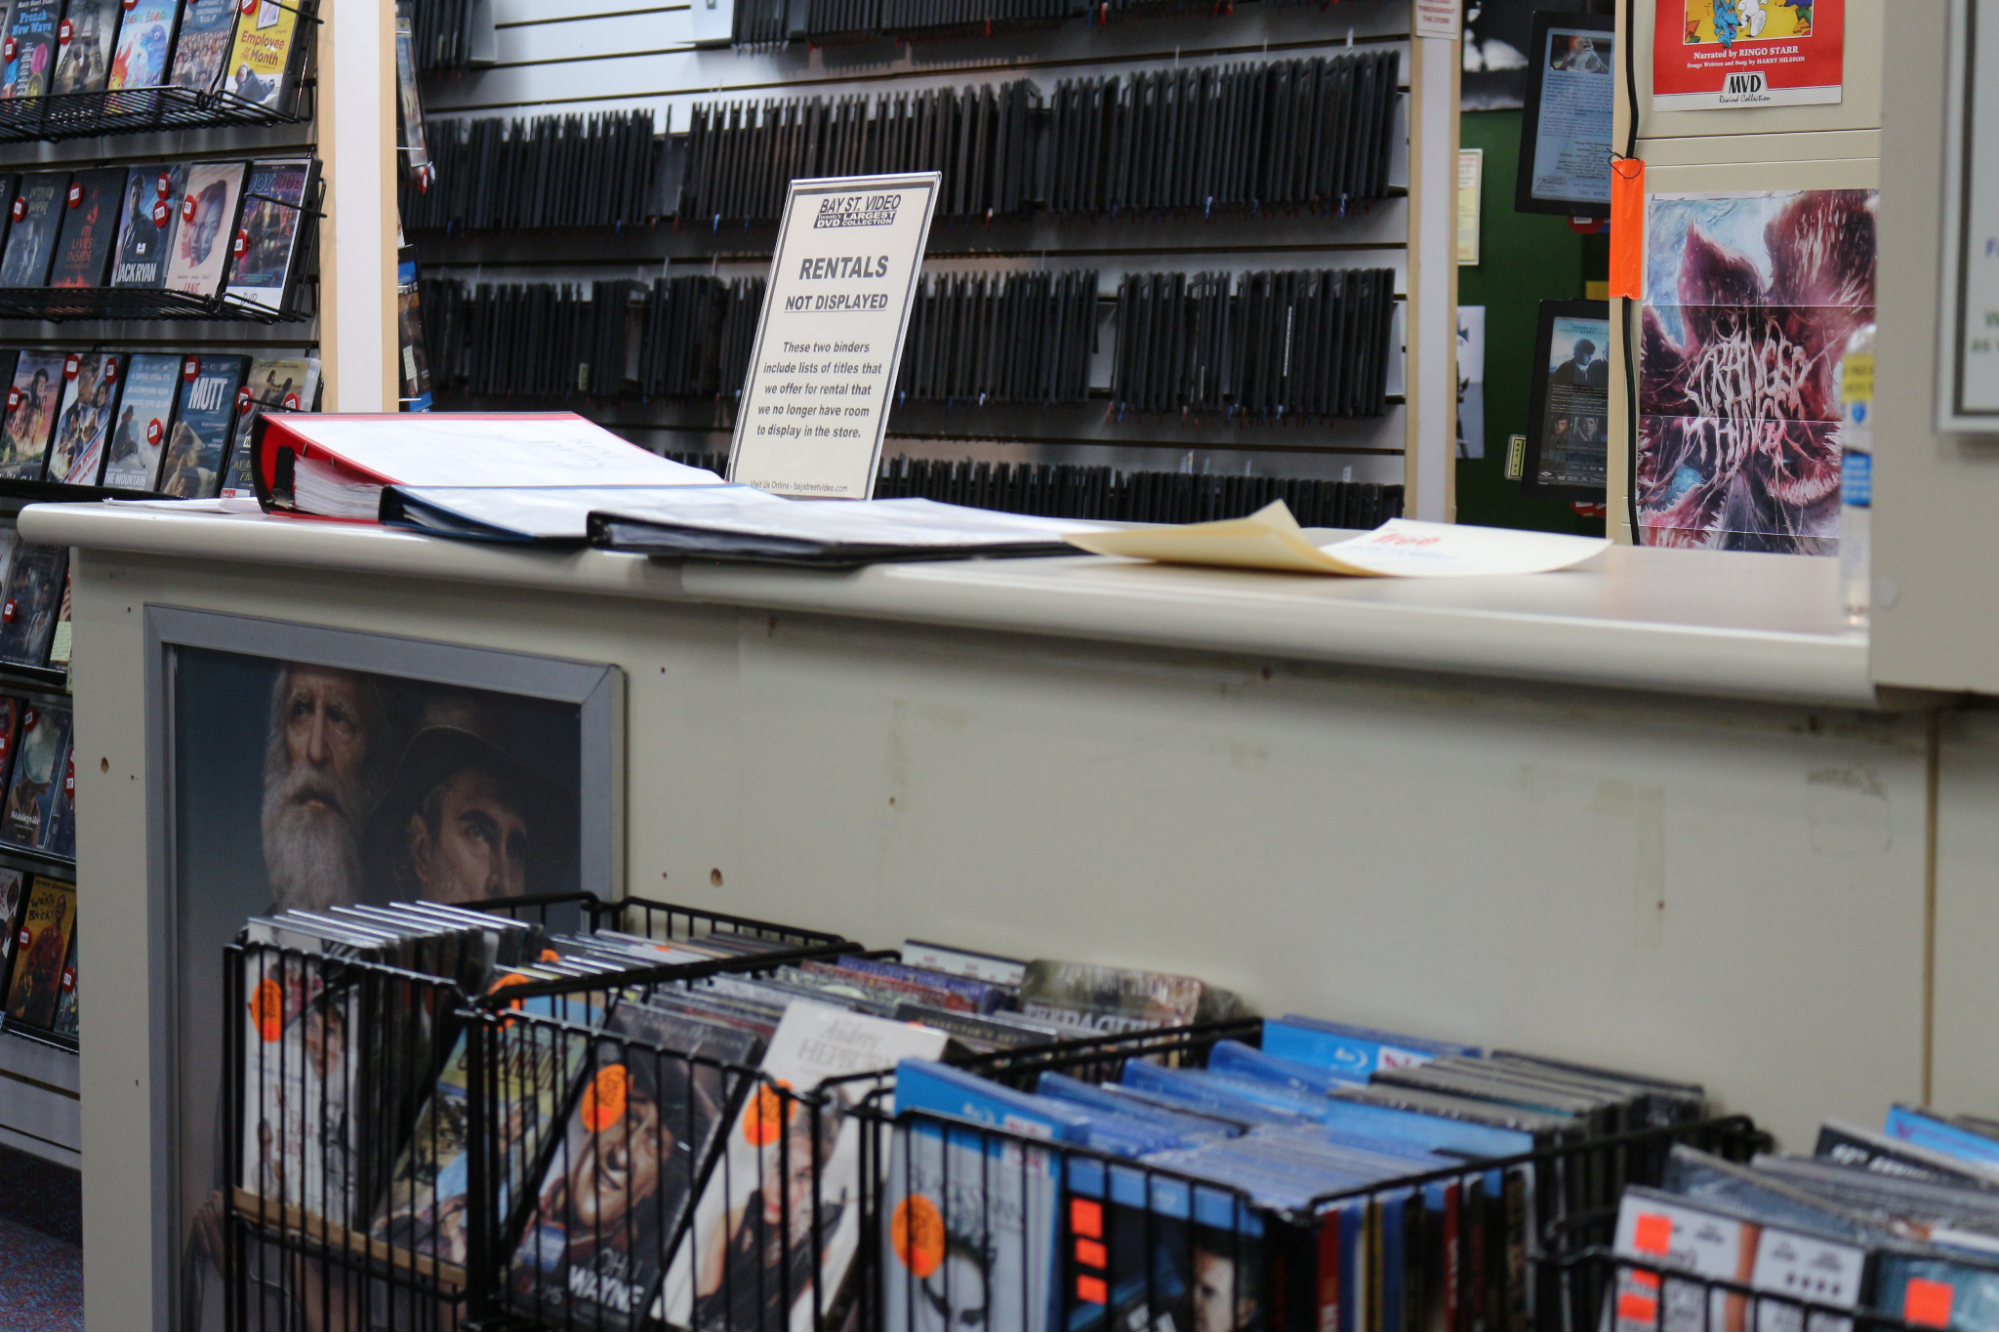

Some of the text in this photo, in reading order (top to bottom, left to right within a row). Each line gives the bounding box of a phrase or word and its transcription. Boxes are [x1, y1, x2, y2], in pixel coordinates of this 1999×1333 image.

[19, 9, 47, 24] French
[11, 22, 52, 36] New Wave
[241, 30, 285, 51] Employee
[250, 48, 279, 66] Month
[1693, 45, 1799, 60] Narrated by RINGO STARR
[1728, 74, 1761, 94] MVD
[1719, 94, 1771, 103] Rewind Collection
[249, 172, 305, 192] JOY RIDE
[819, 193, 902, 214] BAY ST. VIDEO
[842, 210, 896, 220] LARGEST
[816, 218, 893, 228] DVD COLLECTION
[71, 238, 93, 251] LIVES
[66, 250, 93, 263] INSIDE
[116, 262, 157, 283] JACK RYAN
[799, 255, 889, 280] RENTALS
[785, 294, 889, 310] NOT DISPLAYED
[783, 341, 870, 353] These two binders
[763, 362, 882, 374] include lists of titles that
[187, 377, 229, 411] MUTT
[764, 382, 872, 396] we offer for rental that
[758, 403, 869, 419] we no longer have room
[757, 424, 861, 439] to display in the store.
[114, 473, 147, 487] MOUNTAIN
[762, 480, 771, 489] Us
[771, 480, 790, 490] Online
[793, 482, 848, 493] baystreetvideo.com
